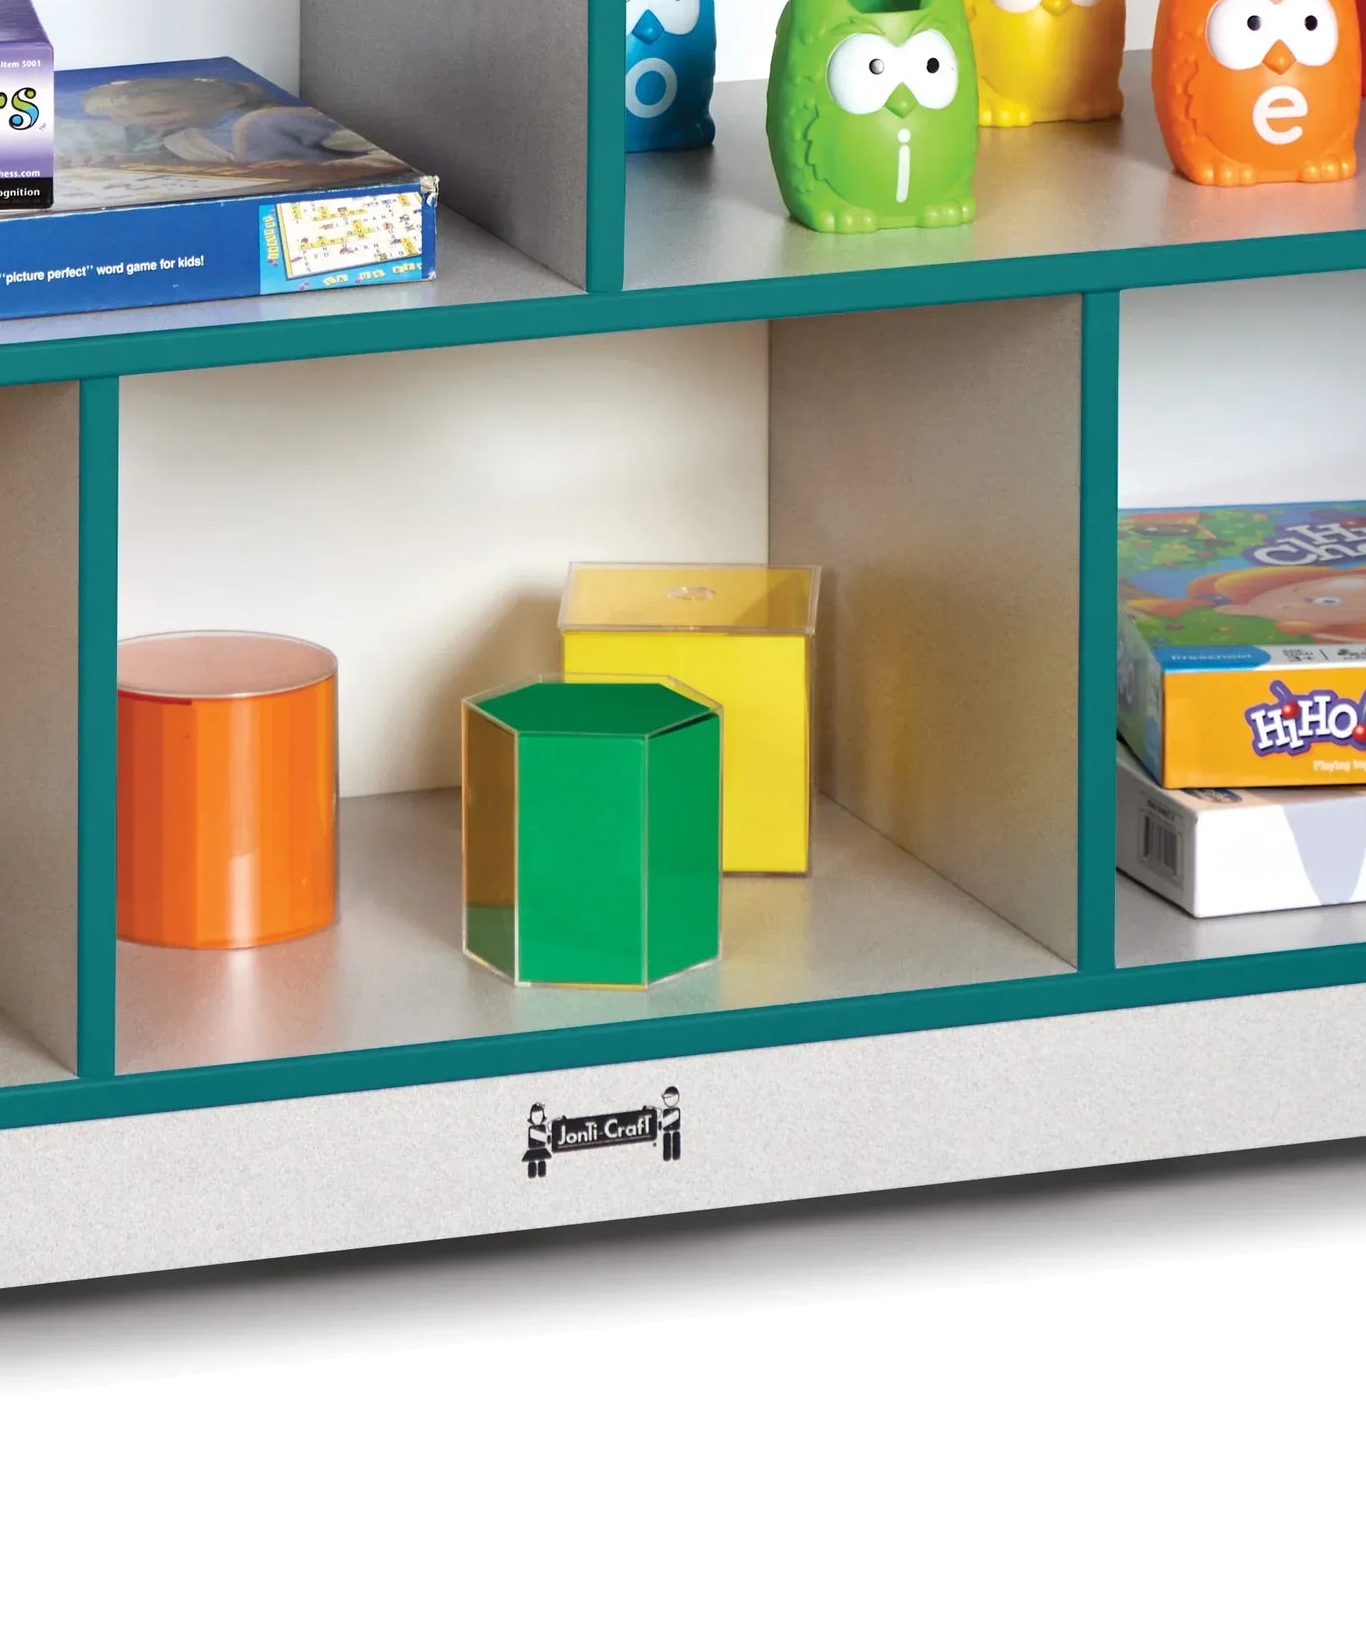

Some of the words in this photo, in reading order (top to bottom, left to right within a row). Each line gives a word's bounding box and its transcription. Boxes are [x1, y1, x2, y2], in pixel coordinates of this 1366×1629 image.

[0, 60, 20, 69] Item
[22, 59, 41, 68] 5001
[626, 58, 677, 117] o
[1252, 86, 1307, 144] e
[895, 128, 911, 204] i
[96, 263, 124, 276] word
[126, 261, 157, 275] game
[160, 259, 175, 270] for
[177, 255, 205, 268] kids!
[1313, 760, 1351, 772] Playing
